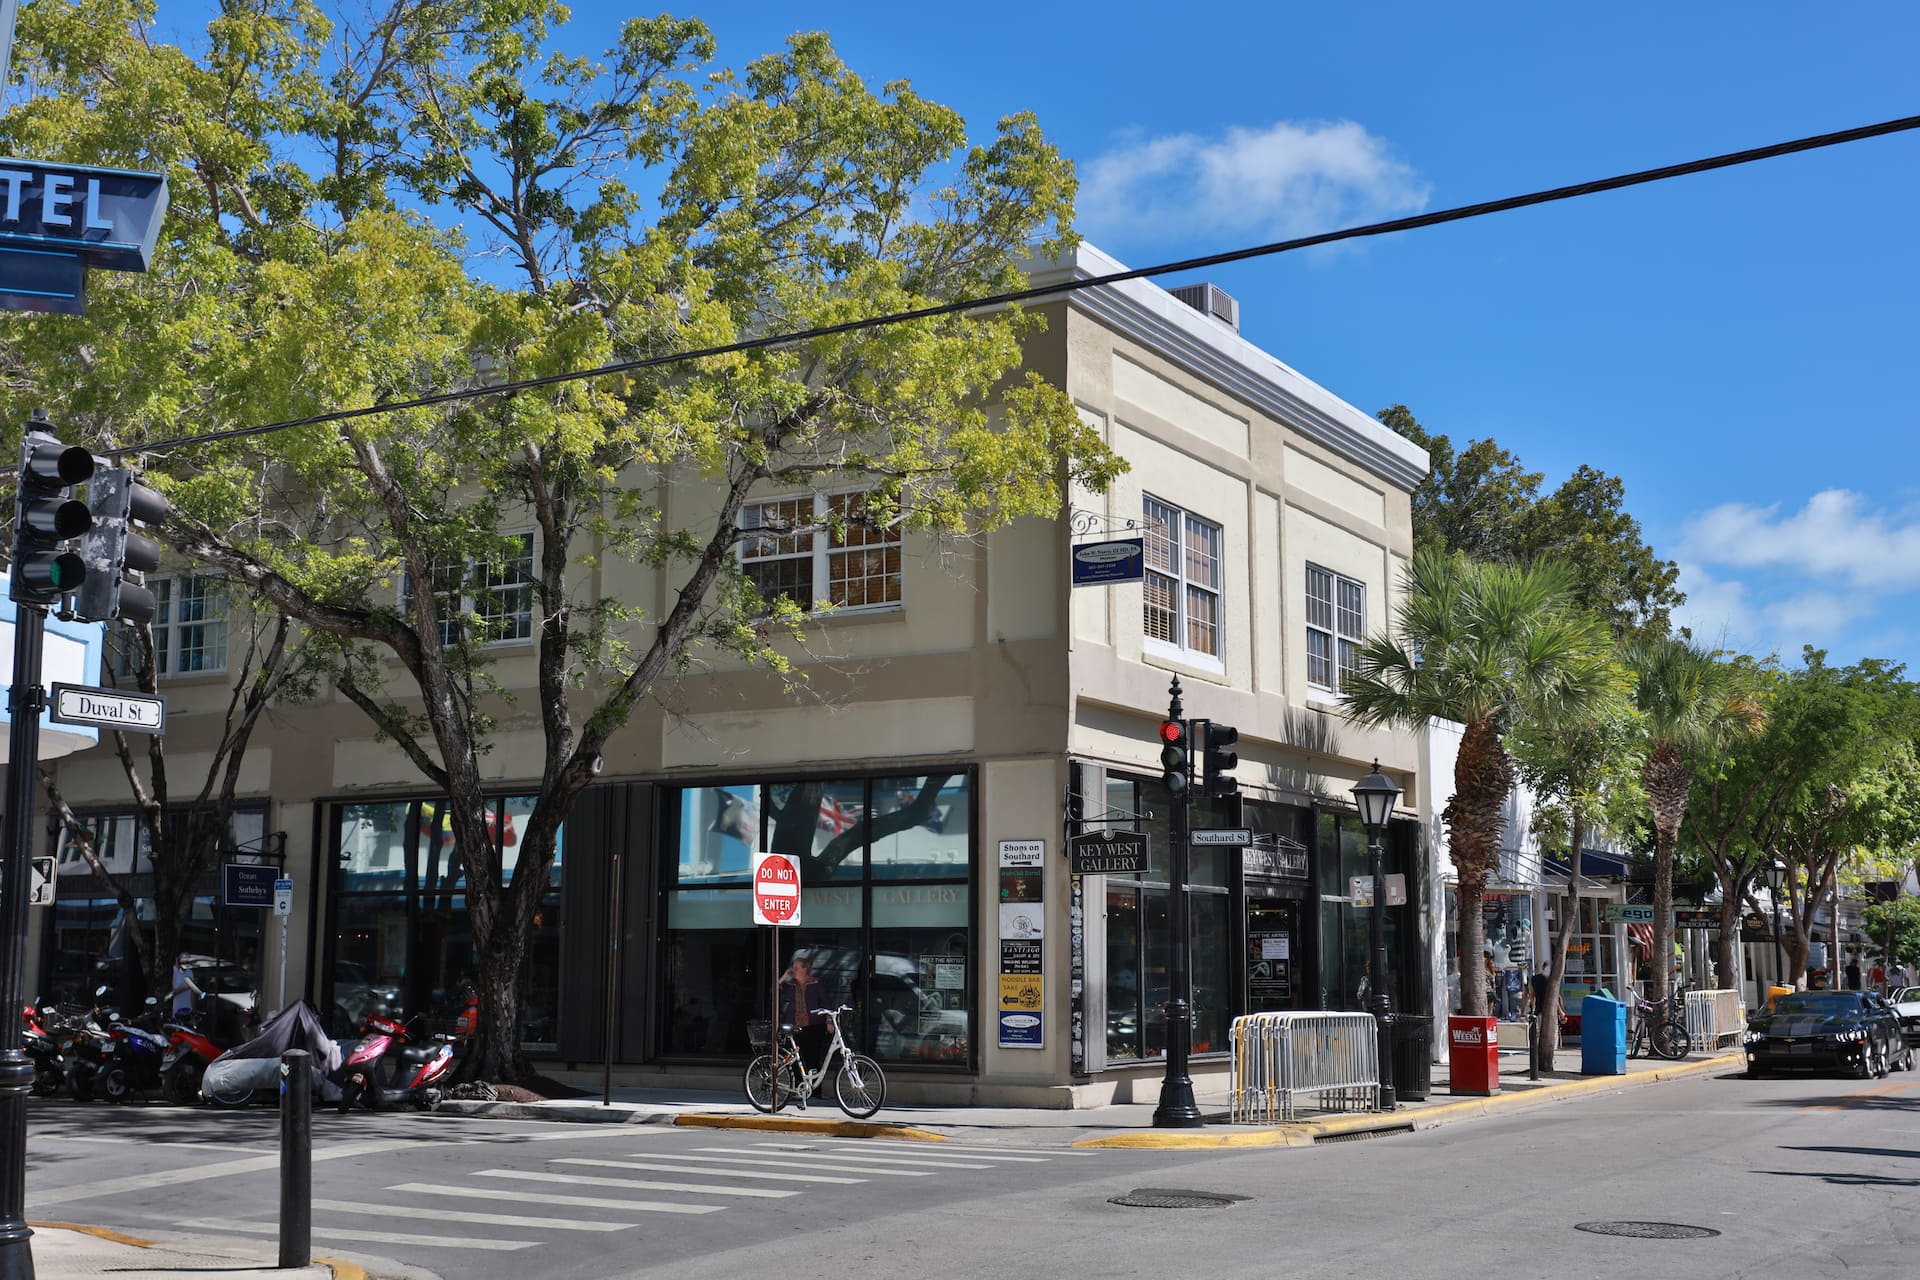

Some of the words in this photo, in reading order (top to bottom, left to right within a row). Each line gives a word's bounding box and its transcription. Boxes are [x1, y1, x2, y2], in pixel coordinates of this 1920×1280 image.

[0, 169, 113, 230] TEL
[80, 697, 122, 718] Duval
[128, 703, 142, 720] St
[1195, 833, 1235, 843] Southard
[1237, 834, 1246, 842] St
[1003, 844, 1027, 852] Shops
[1080, 844, 1104, 857] KEY
[1106, 842, 1141, 856] WEST
[1081, 857, 1138, 871] GALLERY
[761, 867, 773, 879] DO
[777, 869, 794, 881] NOT
[883, 887, 960, 905] GALLERY
[764, 898, 790, 911] ENTER
[1452, 1030, 1482, 1042] WEEKLY
